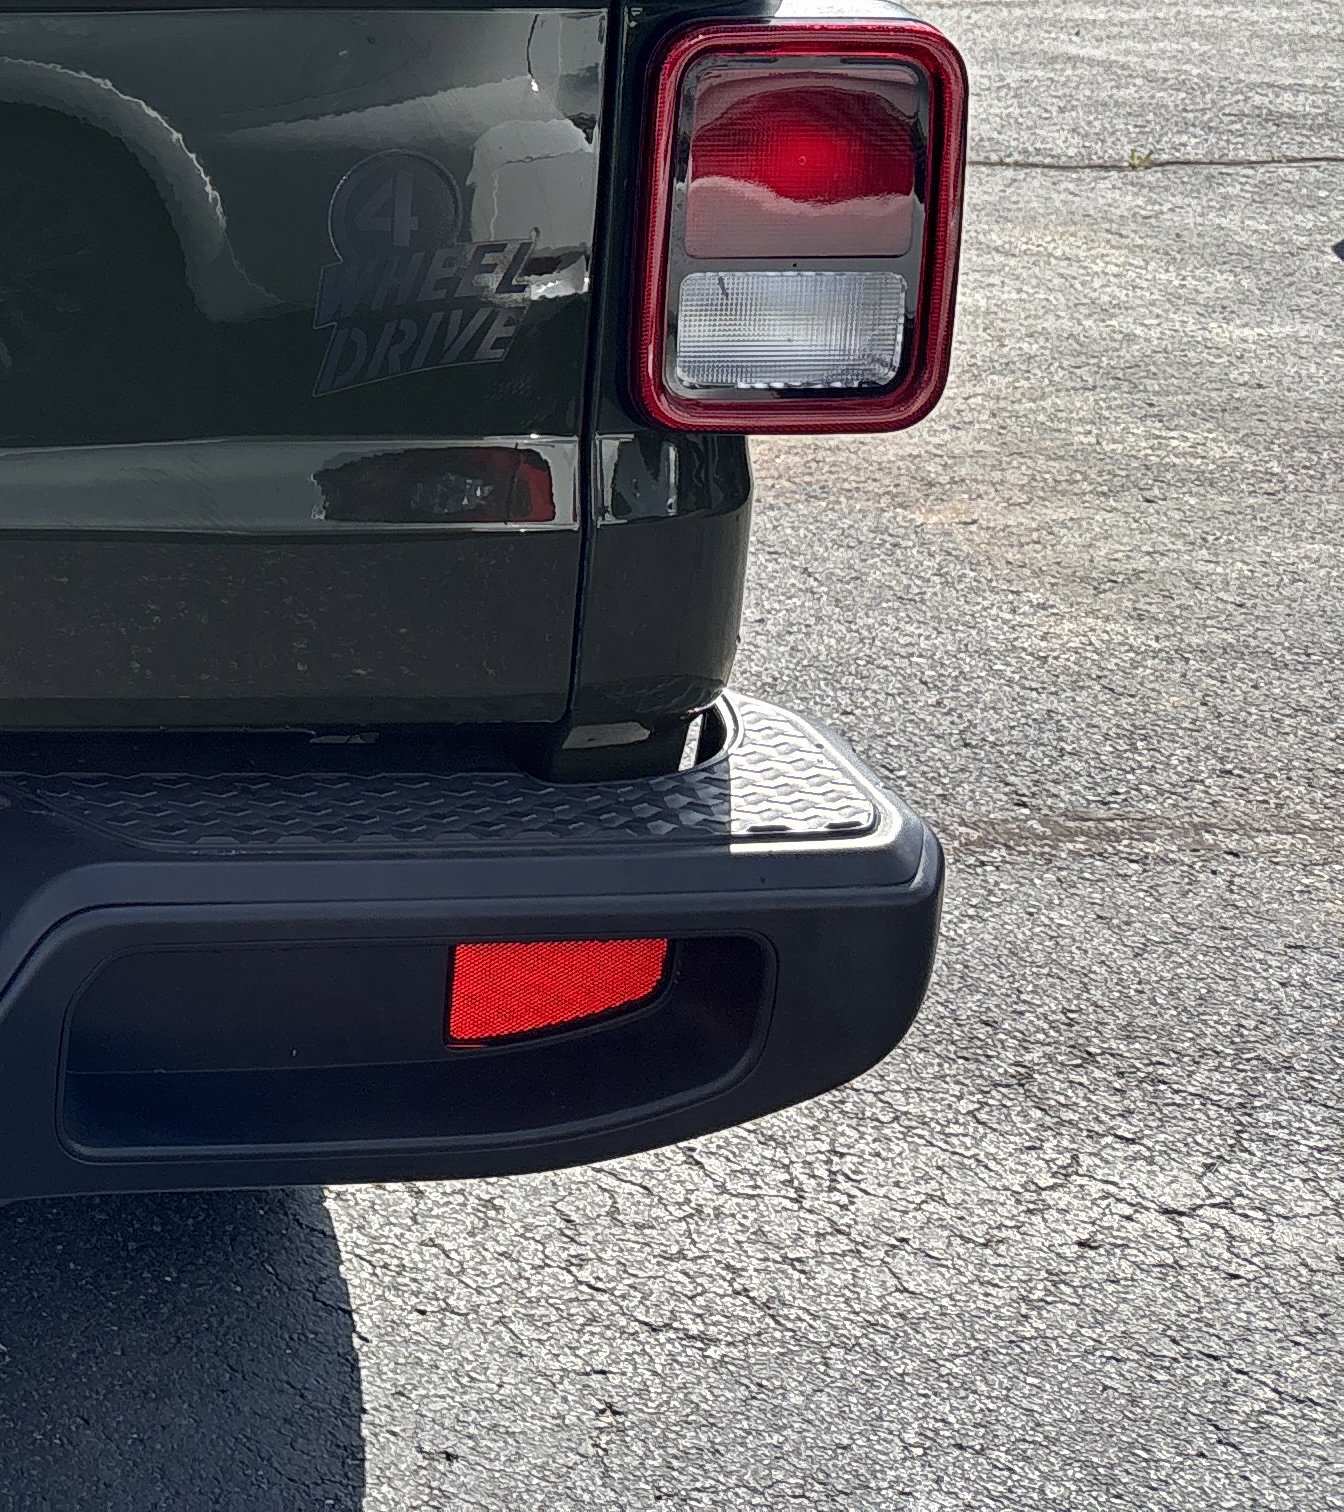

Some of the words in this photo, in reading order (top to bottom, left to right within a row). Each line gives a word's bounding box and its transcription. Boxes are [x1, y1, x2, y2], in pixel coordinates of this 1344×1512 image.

[357, 170, 421, 247] 4
[318, 240, 534, 322] WHEEL
[318, 304, 529, 392] DRIVE
